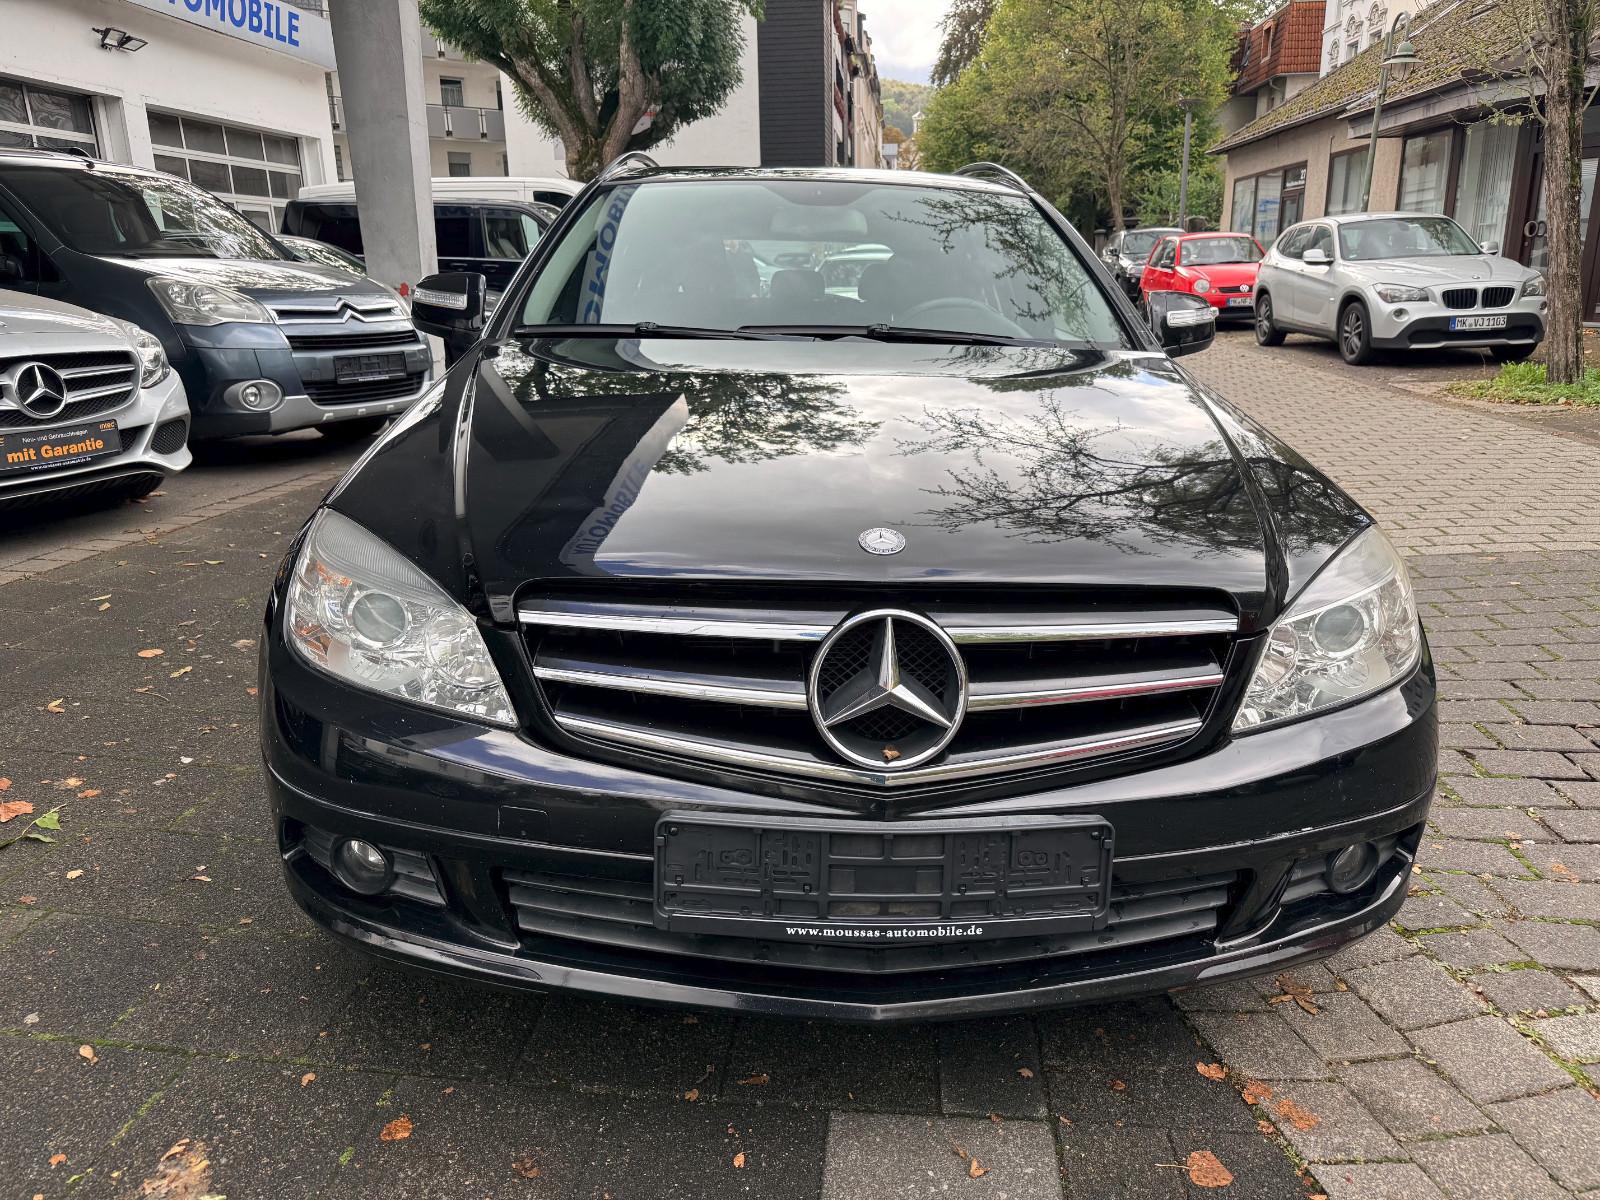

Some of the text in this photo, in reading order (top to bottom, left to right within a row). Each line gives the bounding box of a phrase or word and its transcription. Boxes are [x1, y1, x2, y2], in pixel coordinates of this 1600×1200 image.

[1456, 316, 1506, 328] MK VJ 1103
[7, 438, 104, 463] mit Garantie
[786, 925, 984, 938] www.moussas-automobile.de
